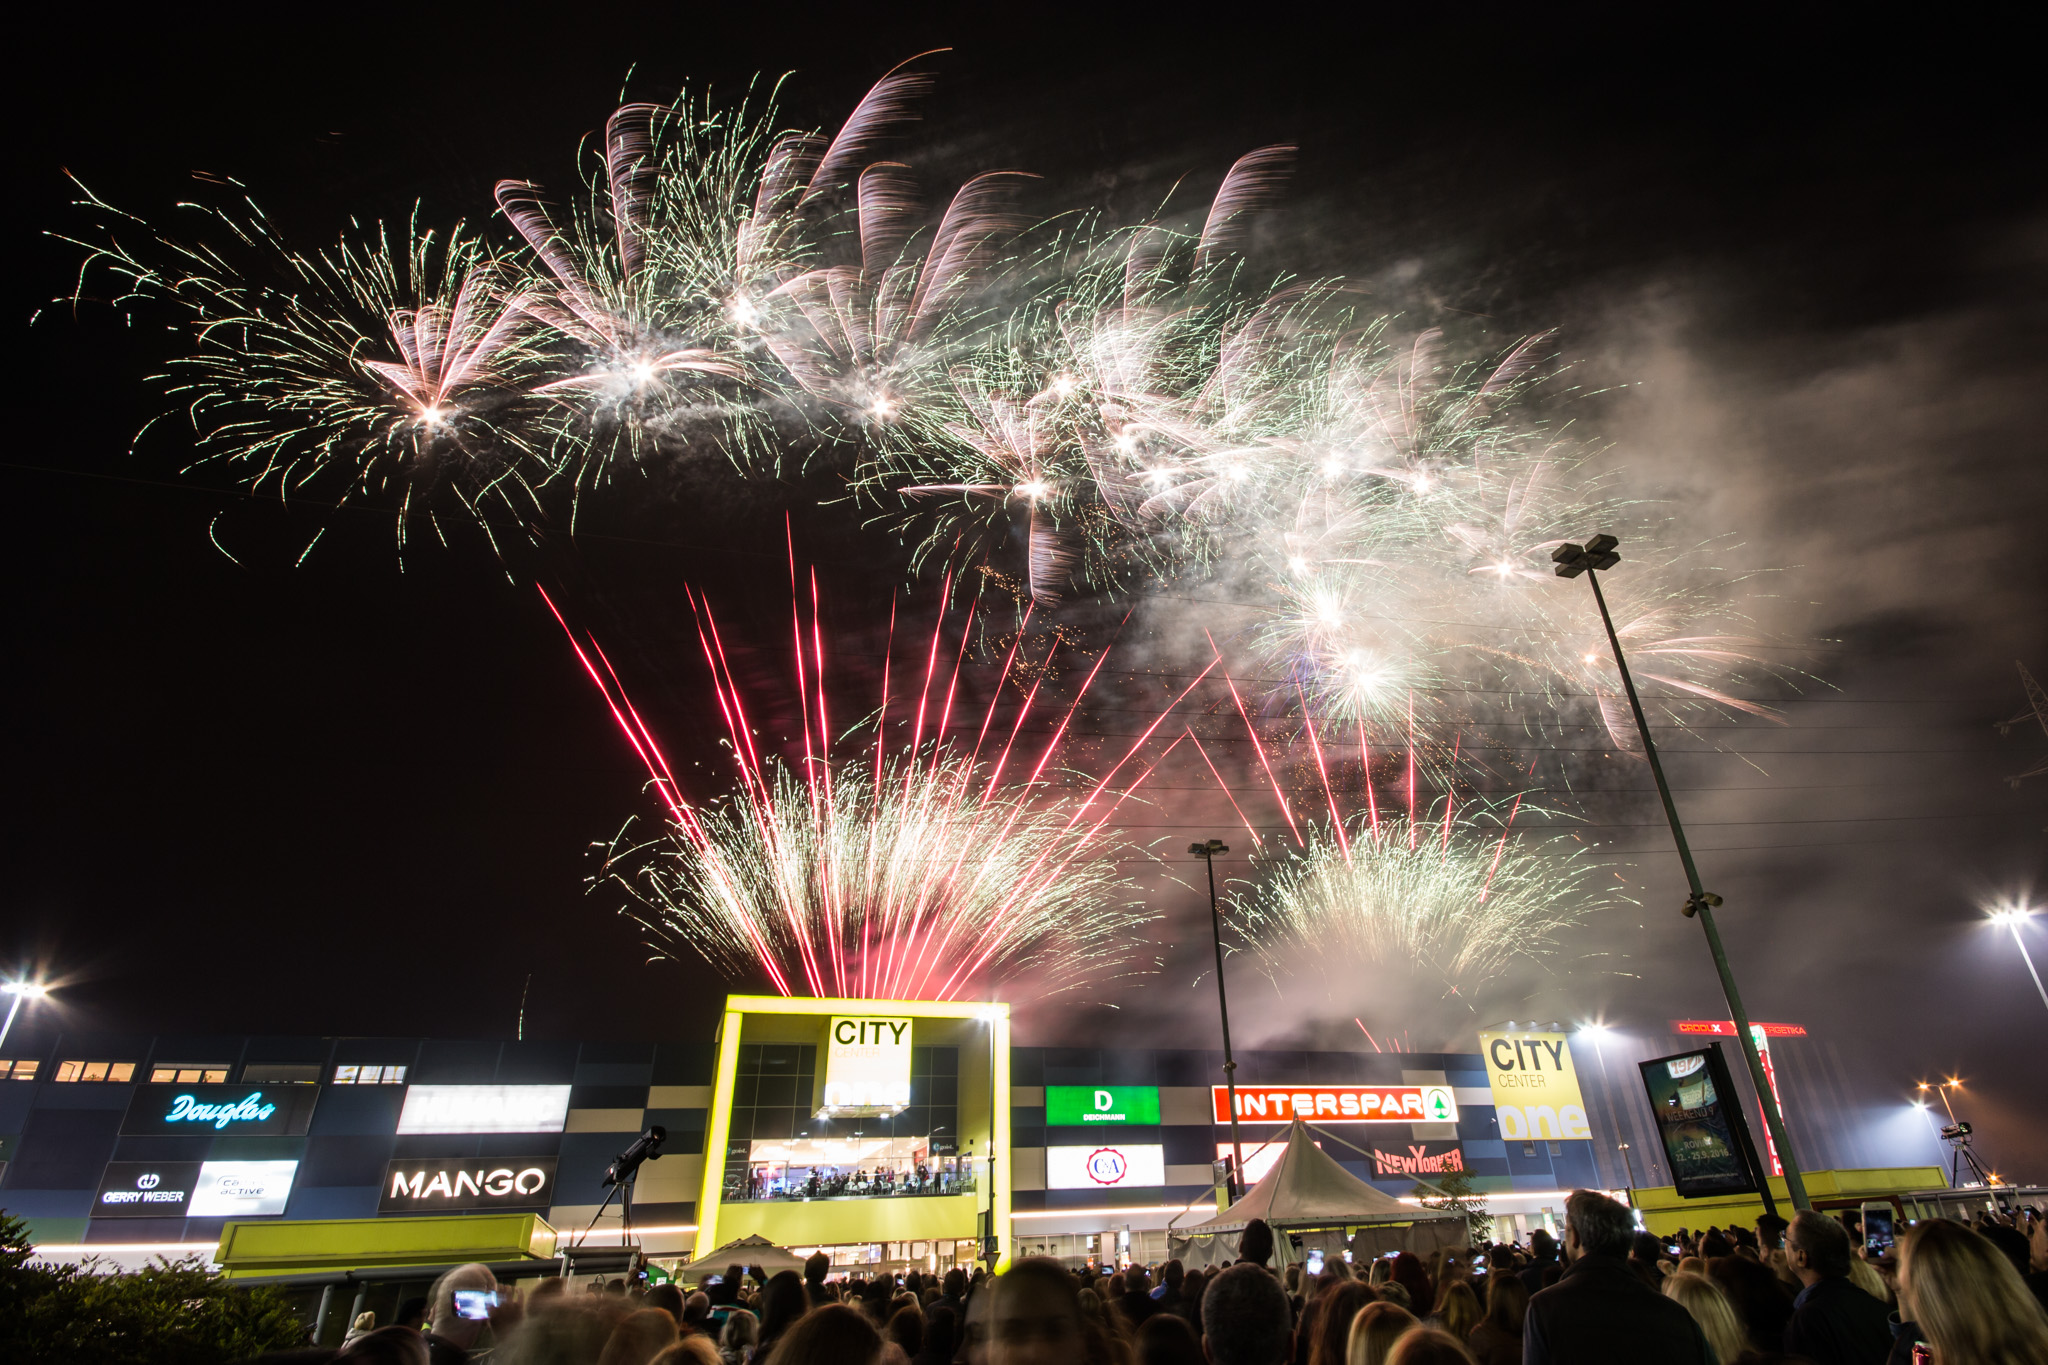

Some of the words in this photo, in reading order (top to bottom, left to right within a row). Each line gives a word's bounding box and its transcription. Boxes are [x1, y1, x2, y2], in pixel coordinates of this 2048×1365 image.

[835, 1020, 908, 1045] CITY
[1679, 1023, 1722, 1033] CRODUX
[1763, 1025, 1807, 1035] ERGETIKA
[835, 1047, 880, 1058] CENTER
[1490, 1038, 1563, 1072] CITY
[1498, 1073, 1546, 1088] CENTER
[1094, 1090, 1113, 1112] D
[1235, 1092, 1424, 1117] INTERSPAR
[165, 1091, 276, 1130] Douglas
[1083, 1113, 1126, 1121] DEICHMANN
[1665, 1107, 1707, 1122] WEEKEND
[1496, 1104, 1593, 1139] one
[1683, 1137, 1712, 1150] ROVI
[390, 1167, 545, 1199] MANGO
[103, 1191, 142, 1204] GERRY
[143, 1190, 185, 1203] WEBER
